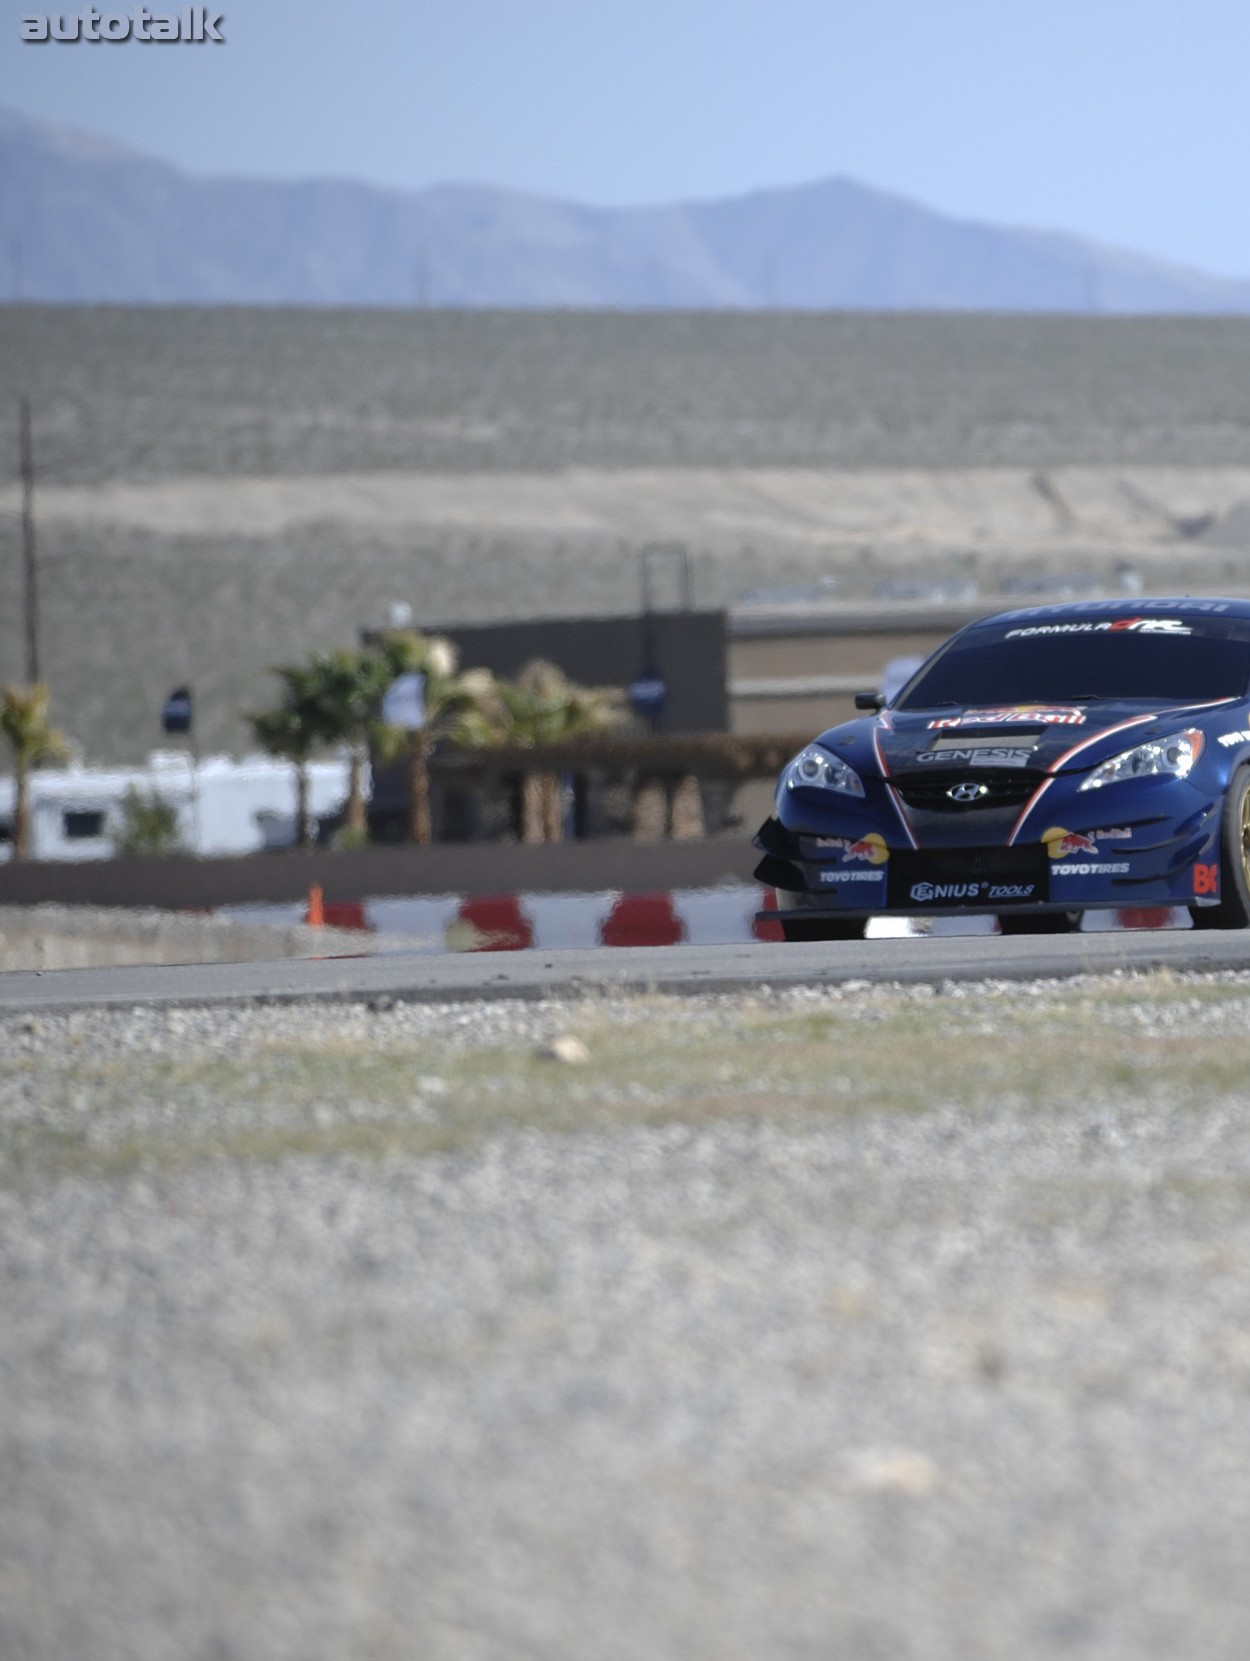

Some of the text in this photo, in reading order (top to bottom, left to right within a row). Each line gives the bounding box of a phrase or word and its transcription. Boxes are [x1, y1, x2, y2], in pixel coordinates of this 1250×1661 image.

[1005, 622, 1110, 639] FORMULA
[916, 748, 1032, 763] GENESIS
[910, 882, 1035, 901] GENIUS TOOLS
